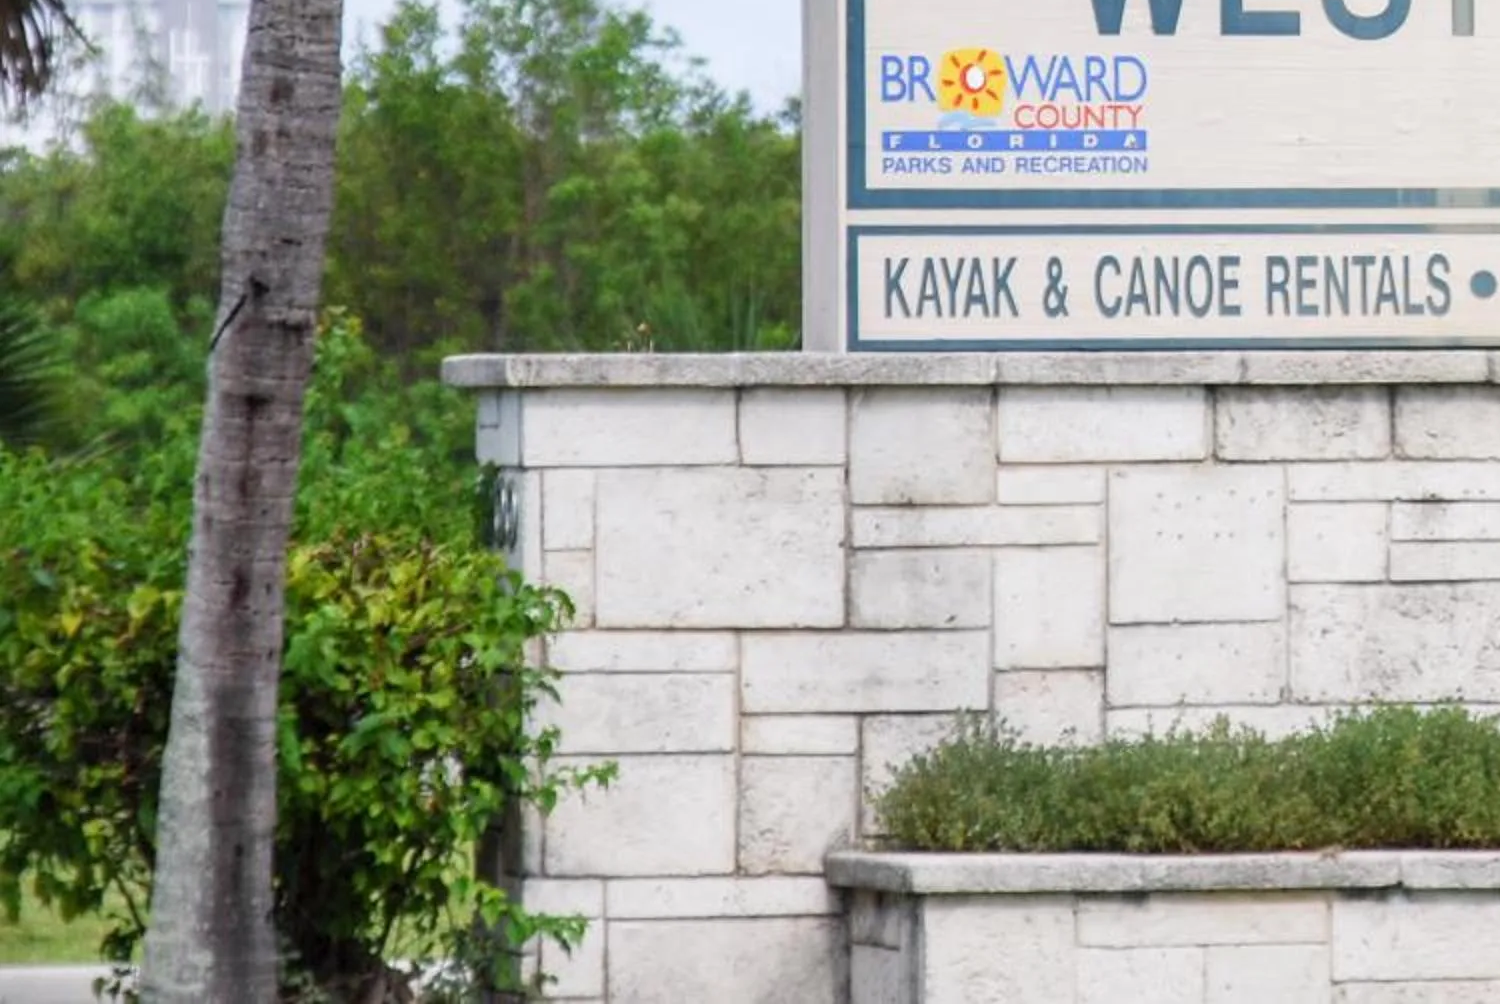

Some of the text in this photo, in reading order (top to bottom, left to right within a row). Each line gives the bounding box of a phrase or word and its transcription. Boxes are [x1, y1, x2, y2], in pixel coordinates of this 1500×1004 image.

[1014, 104, 1142, 129] COUNTY
[889, 133, 1137, 149] FLORIDA
[882, 156, 1148, 174] PARKS AND RECREATION
[884, 257, 1019, 319] KAYAK
[1042, 256, 1069, 318] &
[1094, 254, 1242, 319] CANOE
[1266, 253, 1451, 317] RENTALS
